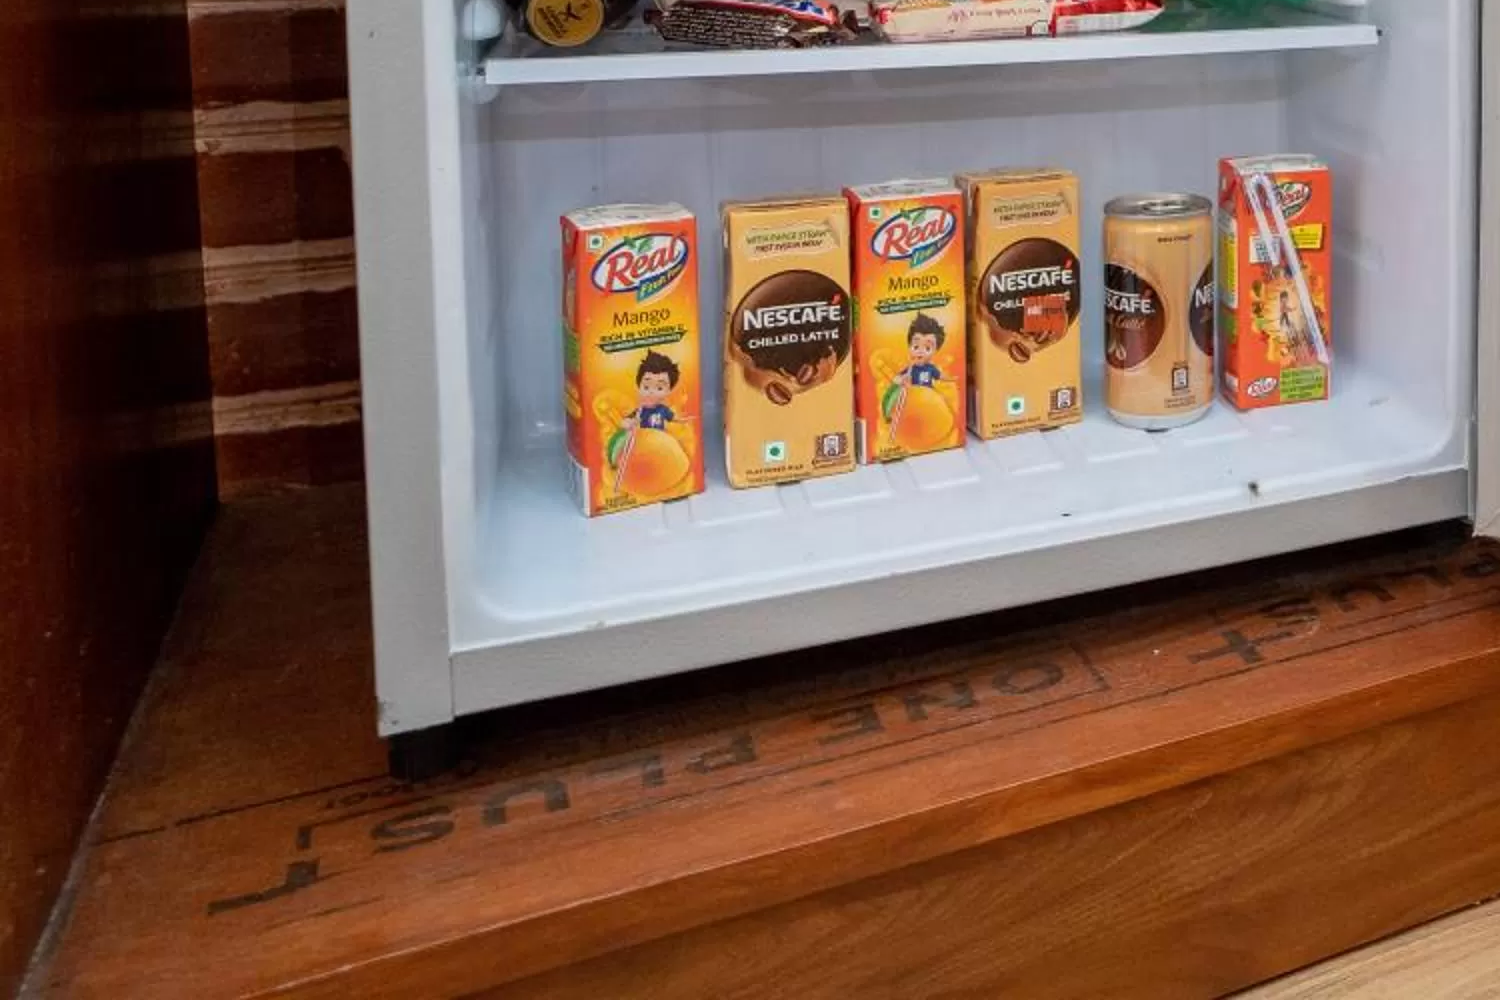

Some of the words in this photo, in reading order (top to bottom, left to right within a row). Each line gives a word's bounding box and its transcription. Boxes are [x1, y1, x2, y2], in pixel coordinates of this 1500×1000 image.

[881, 211, 946, 264] Real
[604, 237, 677, 297] Real
[888, 275, 939, 292] Mango
[613, 307, 671, 327] Mango
[747, 333, 799, 350] CHILLED
[801, 327, 840, 343] LATTE
